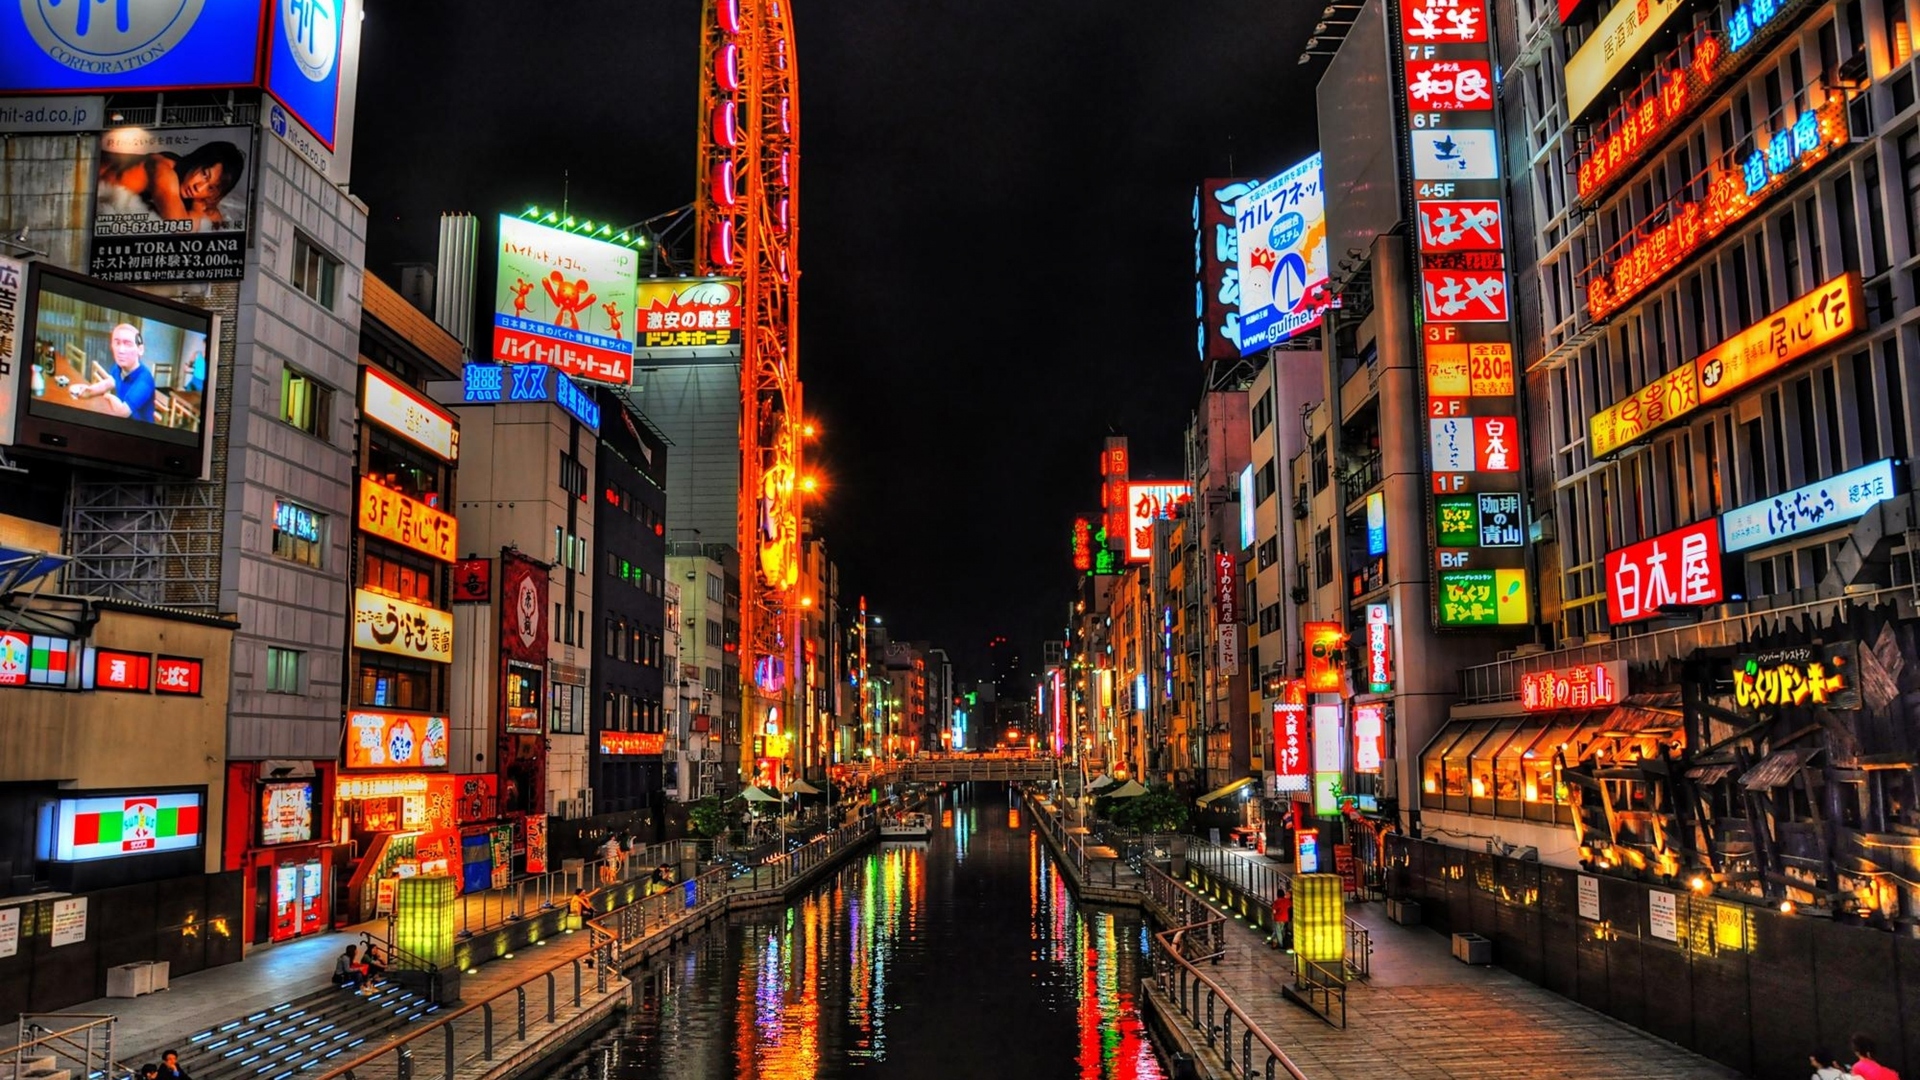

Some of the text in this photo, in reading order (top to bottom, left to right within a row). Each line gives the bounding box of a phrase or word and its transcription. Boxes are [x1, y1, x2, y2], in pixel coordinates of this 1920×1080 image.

[50, 43, 165, 74] CORPORATION
[1409, 69, 1490, 102] 和民
[1432, 101, 1464, 109] わたみ
[289, 125, 326, 172] hit-ad.co.jp
[1239, 182, 1317, 233] ガルフネッ
[97, 220, 192, 234] TEL 06-6214-7845
[1274, 228, 1299, 248] システム
[1421, 207, 1498, 246] はや
[135, 242, 173, 254] TORA
[180, 241, 202, 252] NO
[1589, 229, 1667, 312] 民肉料理
[1425, 277, 1504, 316] はや
[647, 310, 731, 329] 激安の殿堂
[1769, 289, 1845, 358] 居心伝
[501, 317, 628, 350] 日本最大級のバイト情報検索サイト
[501, 338, 625, 378] バイトルドットコム
[1474, 345, 1507, 356] 全品
[1472, 357, 1511, 380] 280円
[1703, 360, 1722, 387] 3F
[1485, 419, 1509, 470] 白木屋
[1442, 508, 1471, 522] びっくり
[1481, 499, 1518, 514] 珈琲
[1493, 513, 1507, 525] の
[398, 498, 449, 555] 居心伝
[1442, 521, 1473, 533] ドンキー
[1483, 525, 1519, 544] 青山
[1440, 552, 1469, 567] B1F
[1615, 533, 1715, 618] 白木屋
[1221, 557, 1233, 622] らーめん専門店
[1446, 583, 1491, 603] びっくり
[1444, 602, 1494, 622] ドンキー
[371, 603, 429, 652] うなぎ
[1758, 649, 1811, 661] ハンバーグレストラン
[110, 659, 127, 683] 酒
[157, 666, 190, 686] たばこ
[1523, 665, 1612, 709] 珈琲の青山
[1733, 662, 1843, 709] びっくりドンキー
